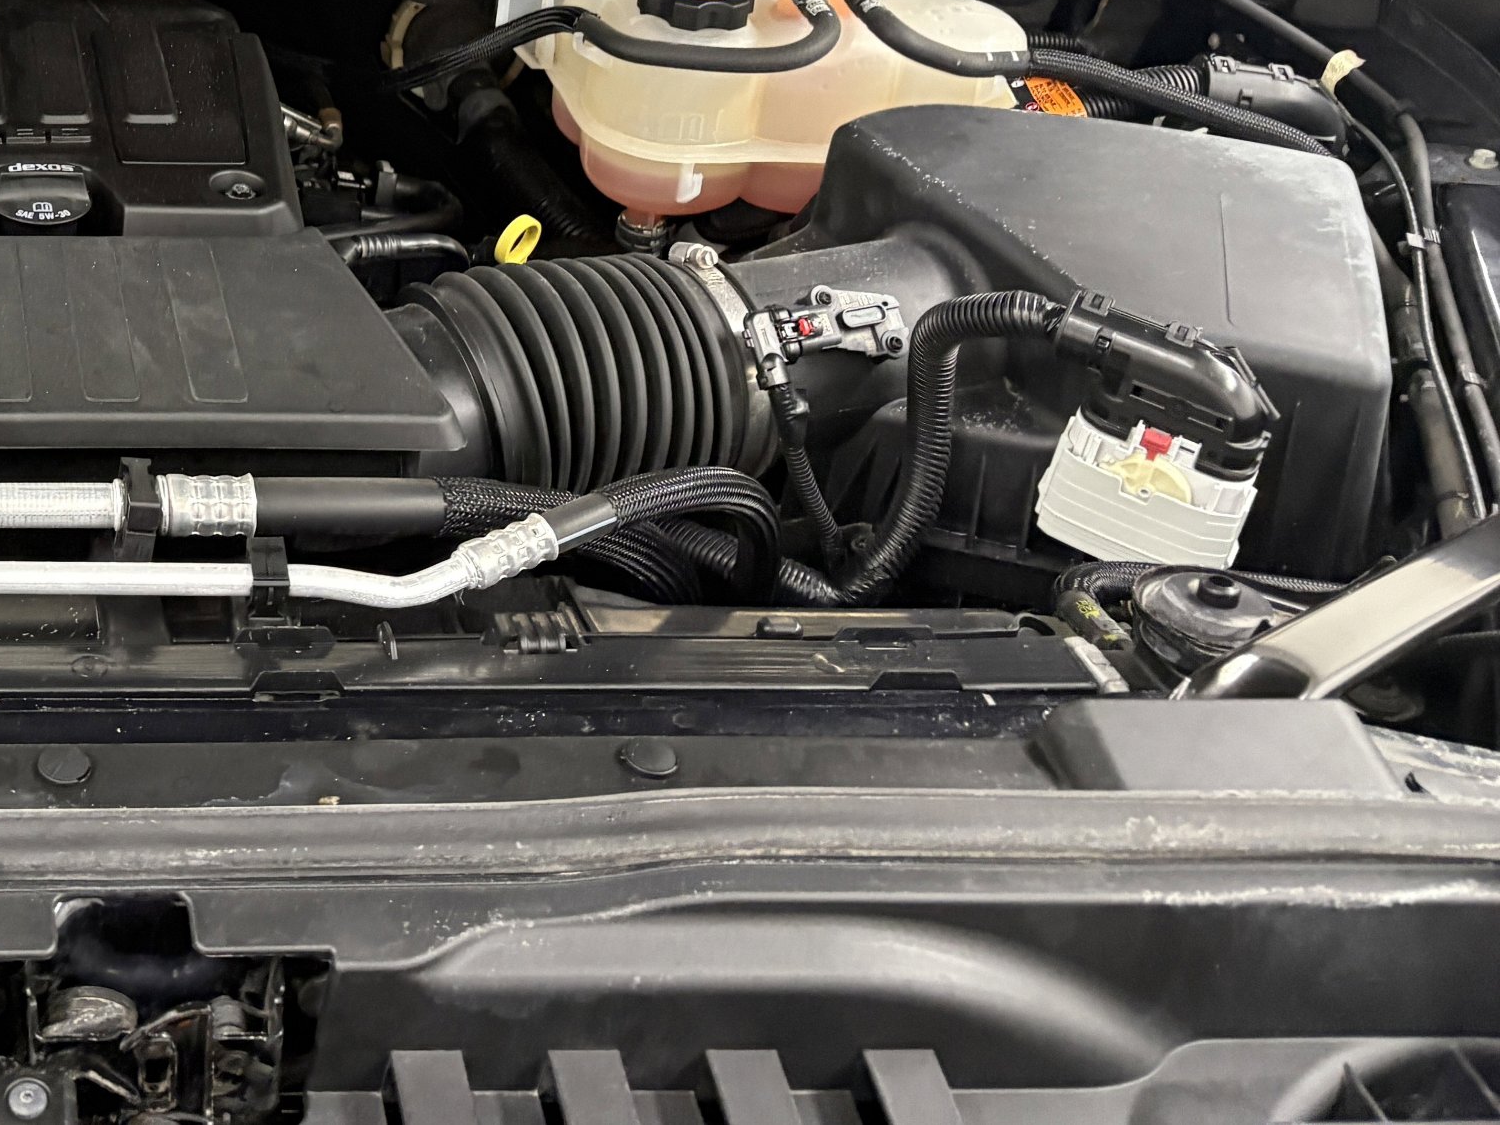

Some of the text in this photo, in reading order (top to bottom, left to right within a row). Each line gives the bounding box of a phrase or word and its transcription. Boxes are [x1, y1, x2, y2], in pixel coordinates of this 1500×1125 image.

[8, 163, 75, 172] dexos
[15, 209, 71, 220] SAE 5W-30
